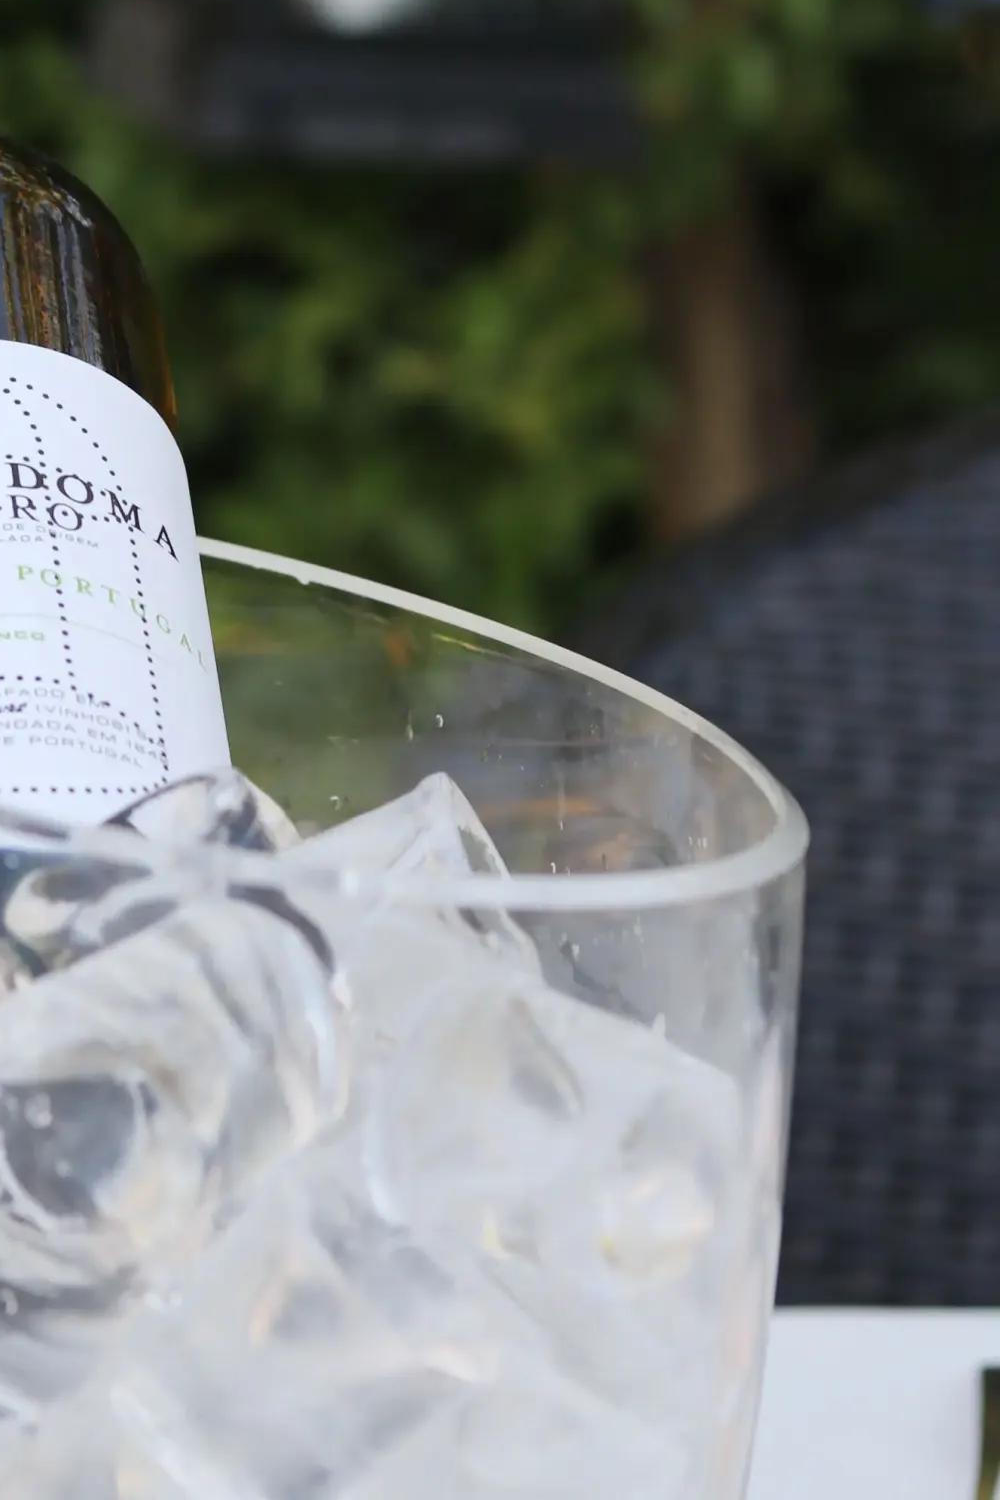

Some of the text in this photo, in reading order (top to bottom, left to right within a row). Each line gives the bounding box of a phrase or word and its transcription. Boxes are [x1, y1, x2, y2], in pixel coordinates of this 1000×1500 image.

[2, 522, 25, 532] DE
[16, 564, 207, 673] PORTUGAL
[28, 735, 142, 769] PORTUGAL
